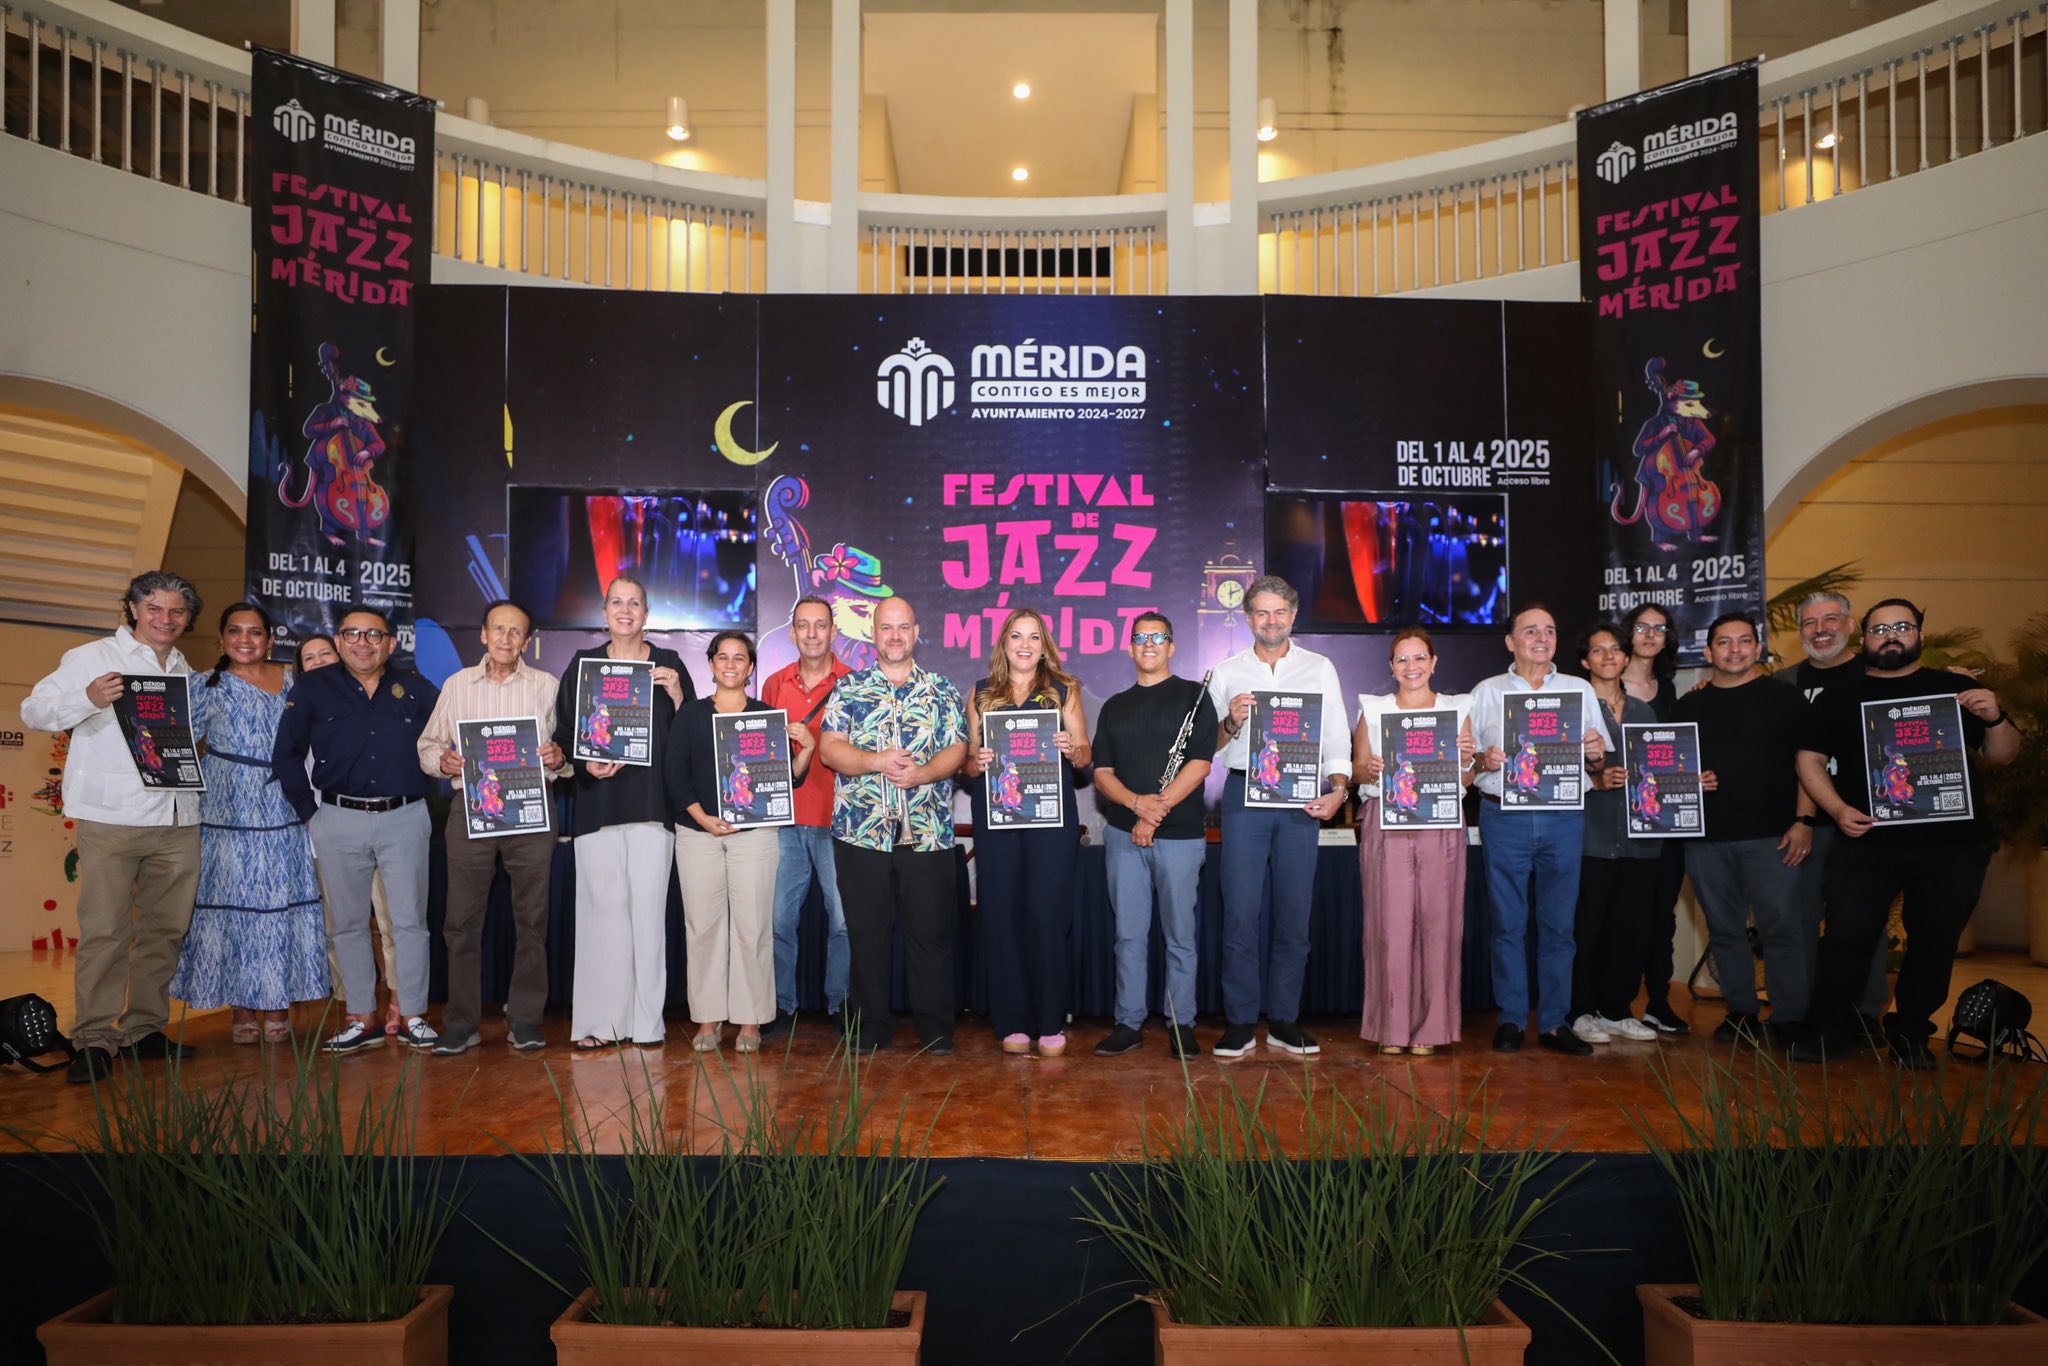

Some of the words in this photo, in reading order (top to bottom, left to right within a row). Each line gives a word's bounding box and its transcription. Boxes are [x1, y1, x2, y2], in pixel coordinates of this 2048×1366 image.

[324, 113, 415, 153] MÉRIDA
[1643, 112, 1737, 153] MÉRIDA
[1646, 145, 1687, 160] CONTIGO
[1704, 132, 1734, 144] MEJOR
[324, 143, 380, 163] AYUNTAMIENTO
[327, 133, 368, 151] CONTIGO
[370, 146, 381, 154] ES
[384, 150, 413, 161] MEJOR
[1644, 151, 1700, 172] AYUNTAMIENTO
[272, 172, 412, 224] FESTIVAL
[1597, 184, 1738, 236] FESTIVAL
[358, 216, 376, 230] DE
[1681, 216, 1700, 228] DE
[270, 204, 413, 271] JAZZ
[1597, 215, 1740, 282] JAZZ
[272, 251, 414, 306] MÉRIDA
[1599, 262, 1741, 319] MÉRIDA
[971, 338, 1146, 378] MÉRIDA
[977, 386, 1053, 397] CONTIGO
[1060, 386, 1078, 398] ES
[1086, 387, 1140, 400] MEJOR
[971, 408, 1075, 419] AYUNTAMIENTO
[1078, 408, 1146, 420] 2024-2027
[1396, 440, 1429, 464] DEL
[1434, 441, 1442, 463] 1
[1448, 441, 1470, 464] AL
[1473, 442, 1486, 464] 4
[1490, 439, 1550, 468] 2025
[943, 474, 1154, 506] FESTIVAL
[1398, 465, 1419, 486] DE
[1421, 466, 1492, 487] OCTUBRE
[1497, 476, 1530, 486] Acceso
[1530, 476, 1550, 486] libre
[1071, 512, 1099, 529] DE
[269, 552, 297, 571] DEL
[301, 555, 309, 572] 1
[314, 556, 332, 574] AL
[335, 560, 346, 576] 4
[360, 560, 411, 587] 2025
[942, 520, 1158, 596] JAZZ
[1604, 567, 1631, 586] DEL
[1634, 567, 1642, 583] 1
[1646, 566, 1664, 583] AL
[1666, 564, 1678, 581] 4
[1692, 554, 1746, 583] 2025
[262, 578, 282, 596] DE
[285, 580, 352, 603] OCTUBRE
[394, 599, 413, 608] libre
[1598, 594, 1617, 611] DE
[1620, 588, 1684, 610] OCTUBRE
[1694, 591, 1727, 604] Acceso
[1728, 590, 1749, 600] libre
[1895, 727, 1929, 738] JAZZ
